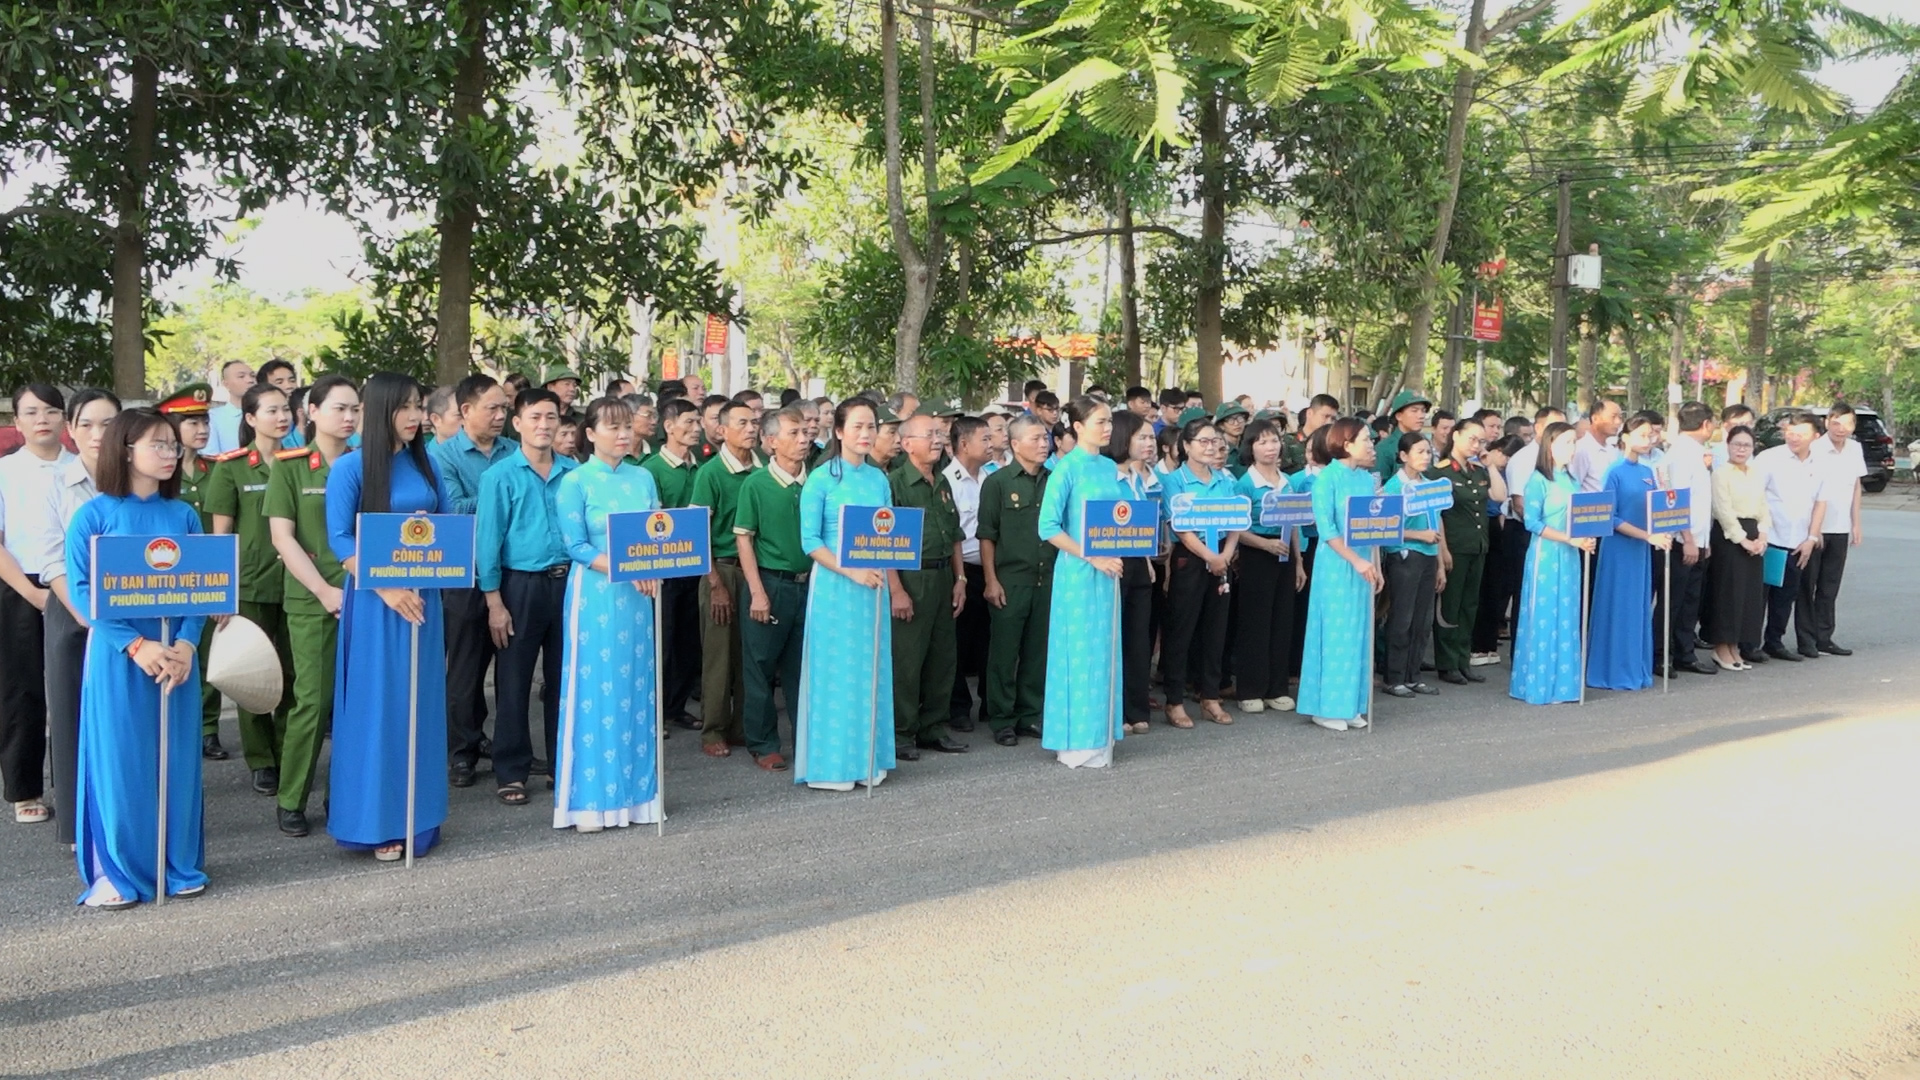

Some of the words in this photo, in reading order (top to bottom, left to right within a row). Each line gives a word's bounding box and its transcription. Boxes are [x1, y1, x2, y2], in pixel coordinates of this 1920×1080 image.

[1088, 526, 1101, 538] HỘI
[1101, 527, 1116, 539] CỰU
[1117, 526, 1138, 537] CHIẾN
[628, 543, 659, 557] CÔNG
[662, 540, 692, 555] ĐOÀN
[854, 534, 868, 548] HỘI
[870, 535, 892, 547] NÔNG
[893, 536, 910, 548] DÂN
[392, 547, 423, 562] CÔNG
[427, 549, 442, 562] AN
[849, 549, 875, 559] PHƯỜNG
[876, 549, 893, 560] ĐÔNG
[895, 551, 915, 561] QUANG
[619, 558, 652, 572] PHƯỜNG
[653, 557, 675, 569] ĐÔNG
[676, 555, 702, 568] QUANG
[370, 565, 407, 577] PHƯỜNG
[409, 565, 434, 577] ĐÔNG
[436, 566, 465, 578] QUANG
[103, 572, 117, 590] ỦY
[121, 575, 144, 589] BAN
[147, 574, 176, 588] MTTQ
[179, 572, 201, 590] VIỆT
[204, 573, 229, 587] NAM
[109, 592, 155, 606] PHƯỜNG
[157, 590, 188, 604] ĐÔNG
[190, 591, 226, 604] QUANG
